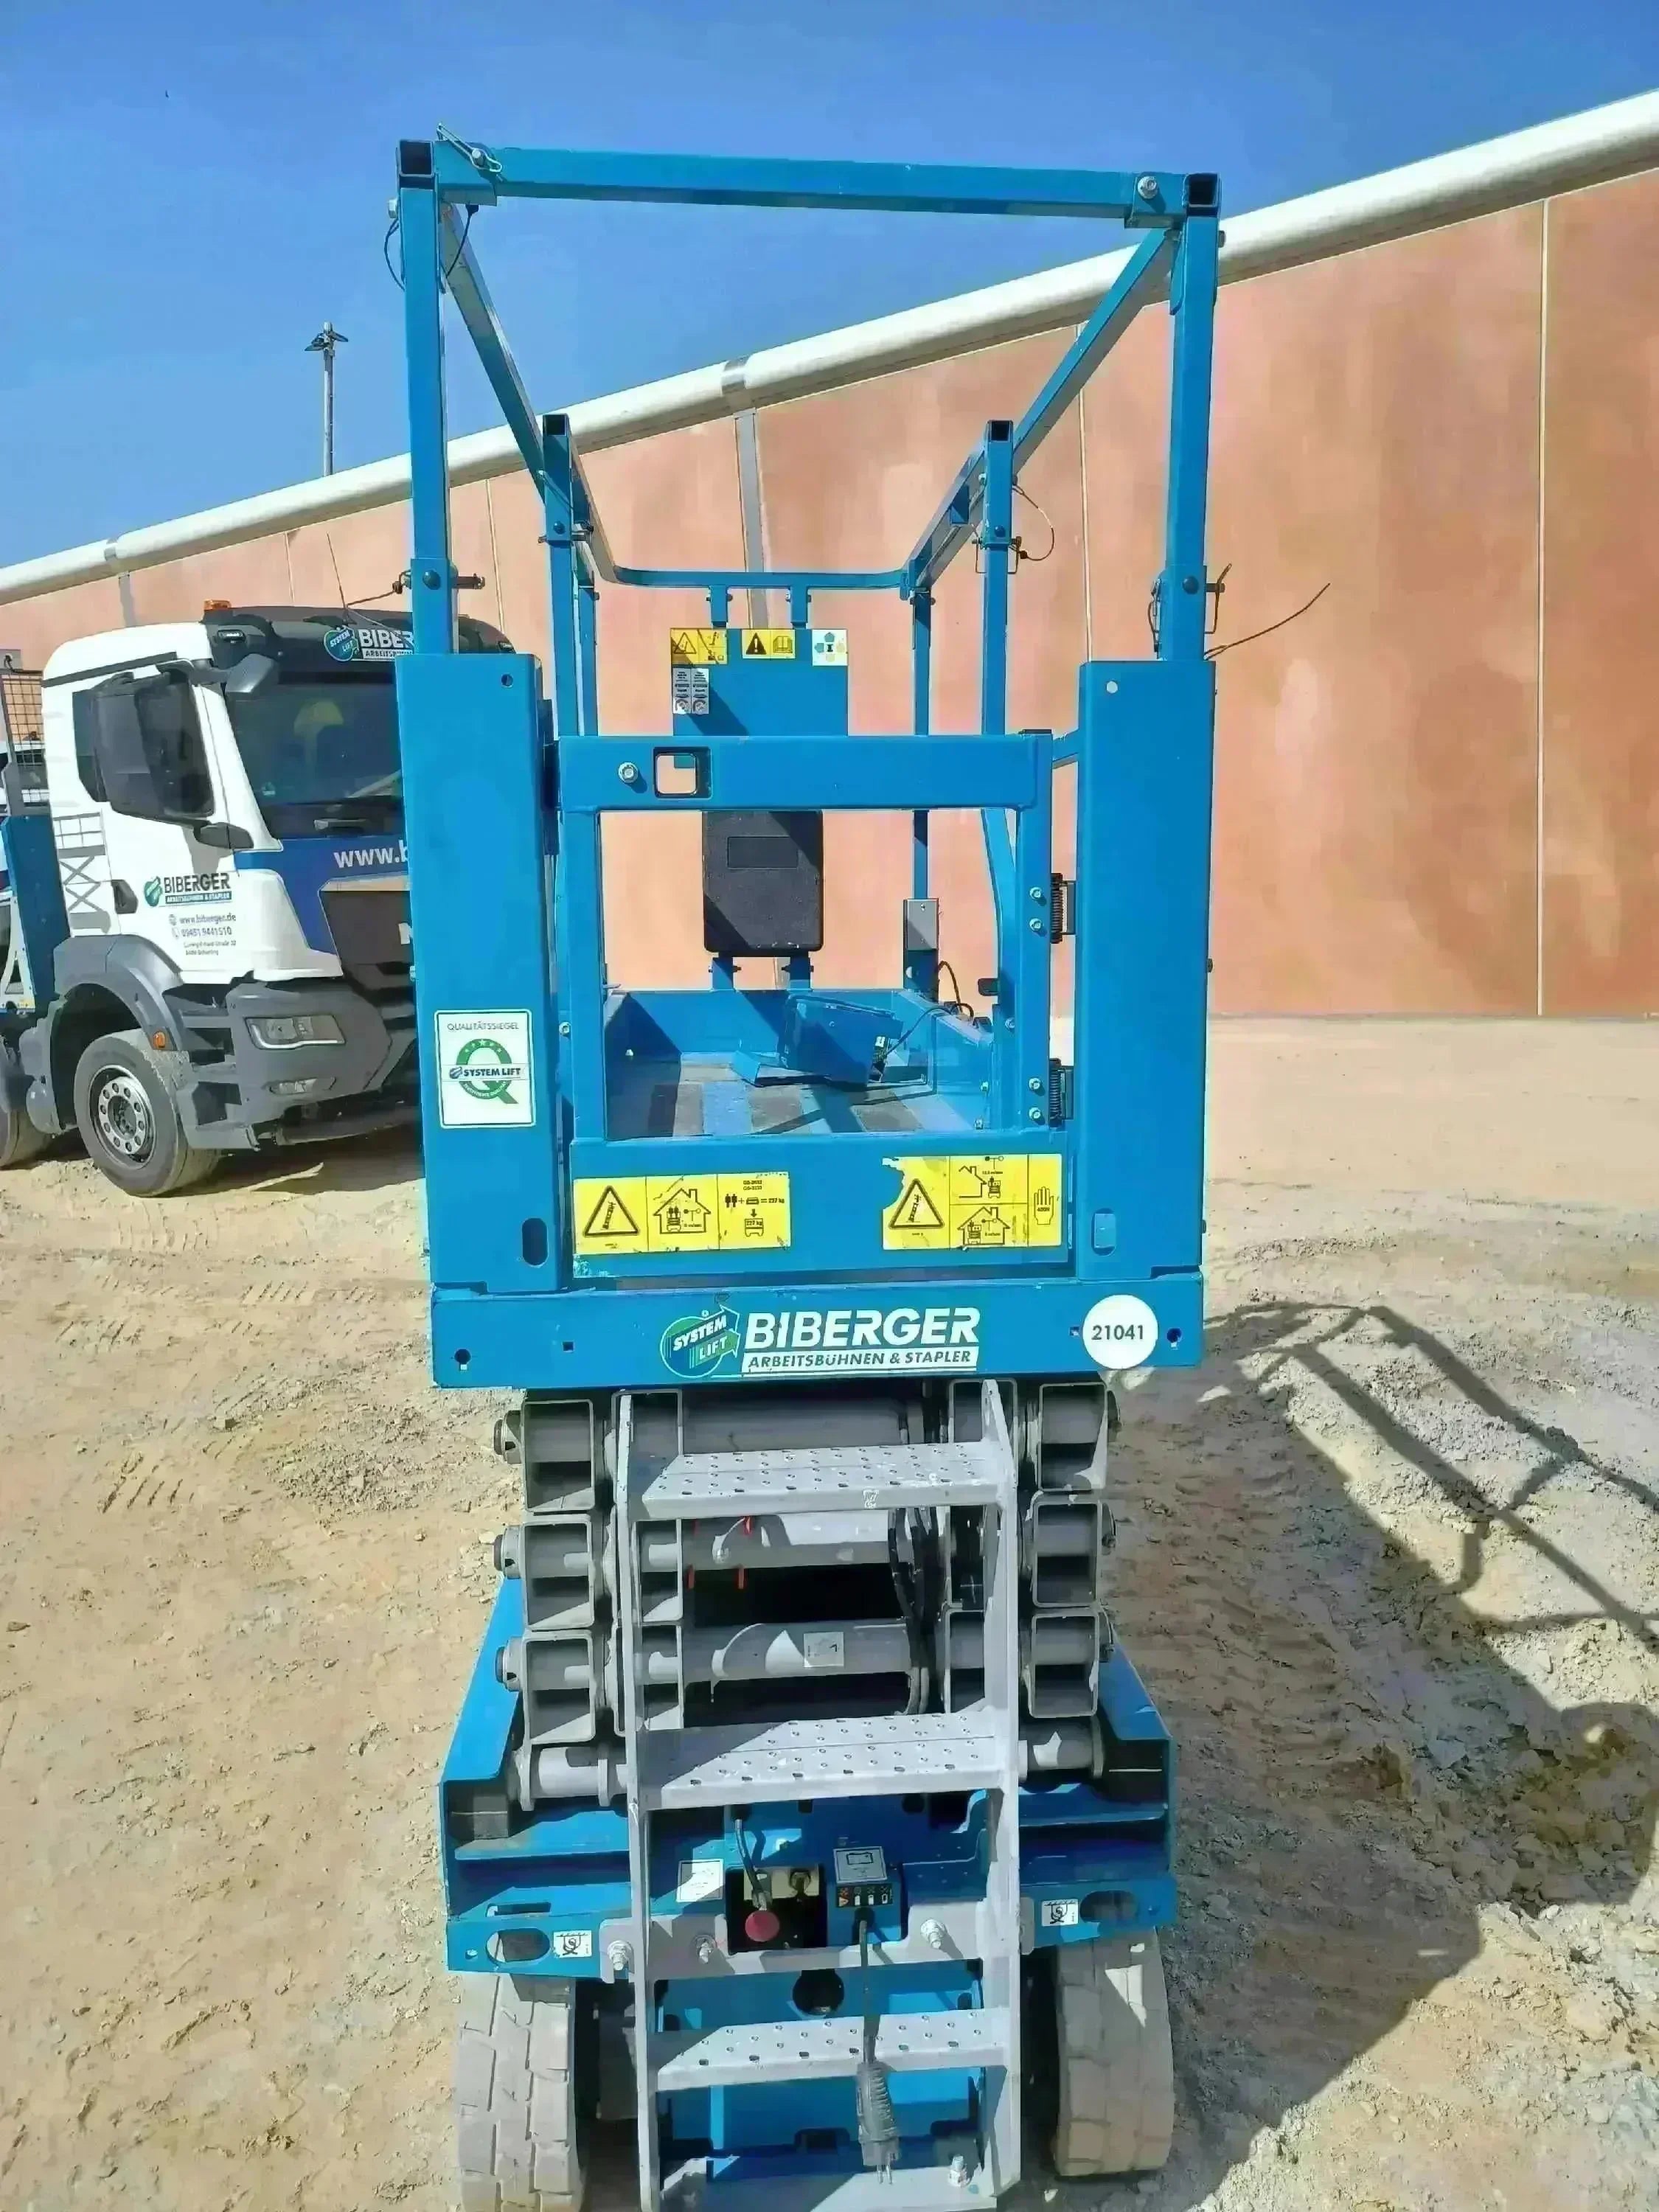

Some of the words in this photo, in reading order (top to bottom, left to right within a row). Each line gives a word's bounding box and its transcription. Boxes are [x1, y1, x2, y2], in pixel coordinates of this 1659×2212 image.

[164, 873, 231, 894] BIBERGER
[447, 1020, 519, 1031] QUALITÄTSSIEGEL
[463, 1068, 501, 1077] SYSTEM
[501, 1068, 521, 1076] LIFT
[673, 1315, 727, 1352] SYSTEM
[743, 1307, 981, 1350] BIBERGER
[1091, 1324, 1144, 1340] 21041
[699, 1335, 728, 1360] LIFT
[748, 1352, 885, 1368] ARBEITSBÜHNEN
[890, 1351, 901, 1364] &
[905, 1350, 971, 1364] STAPLER
